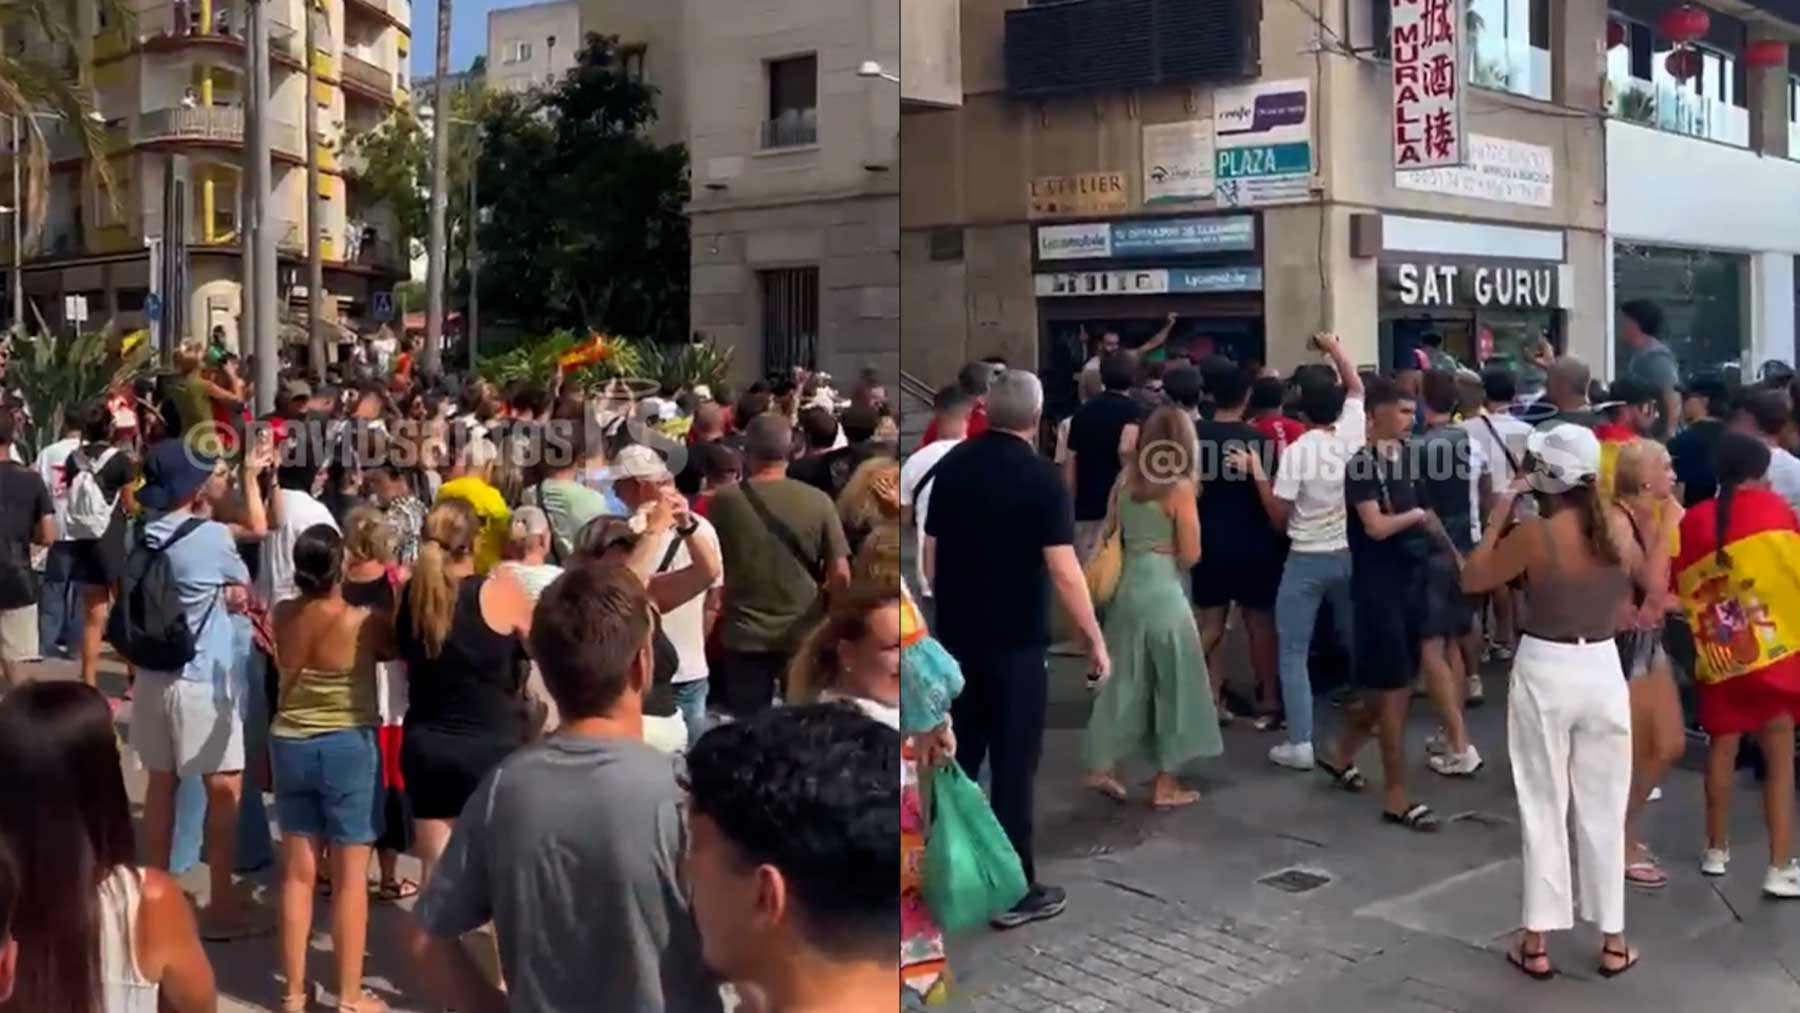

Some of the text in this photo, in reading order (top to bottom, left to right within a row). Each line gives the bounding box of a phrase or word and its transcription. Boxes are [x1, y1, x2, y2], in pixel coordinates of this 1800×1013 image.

[1394, 23, 1421, 165] MURALLA
[1219, 147, 1276, 176] PLAZA
[1399, 262, 1551, 306] SAT GURU
